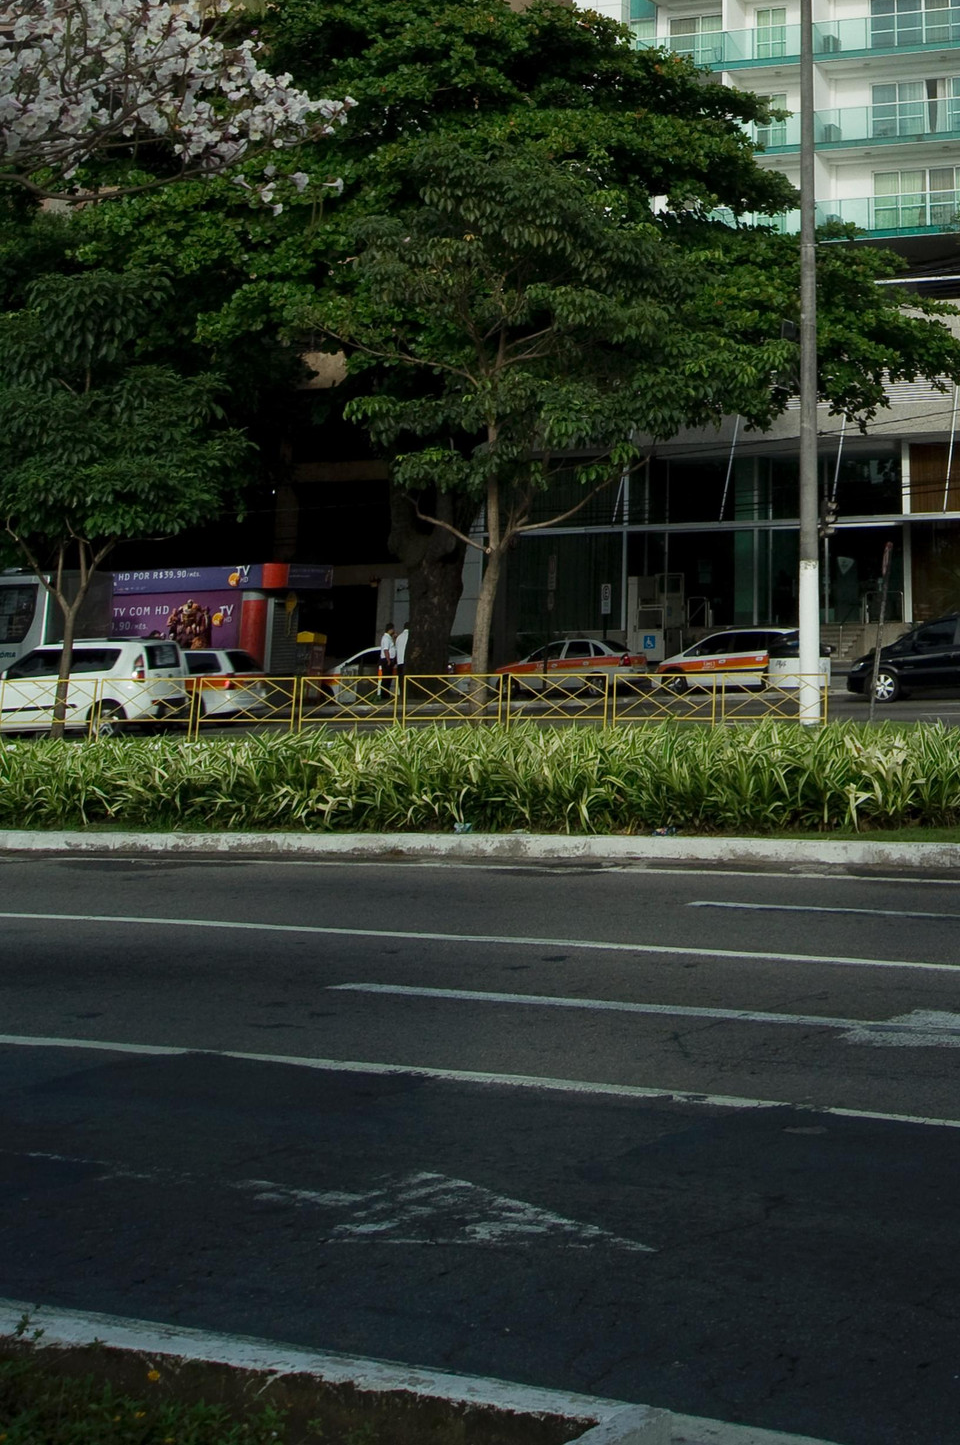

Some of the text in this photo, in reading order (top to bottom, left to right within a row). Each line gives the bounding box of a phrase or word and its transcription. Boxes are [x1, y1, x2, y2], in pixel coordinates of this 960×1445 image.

[118, 572, 130, 581] HD
[133, 571, 150, 580] POR
[113, 605, 170, 617] TV COM HD
